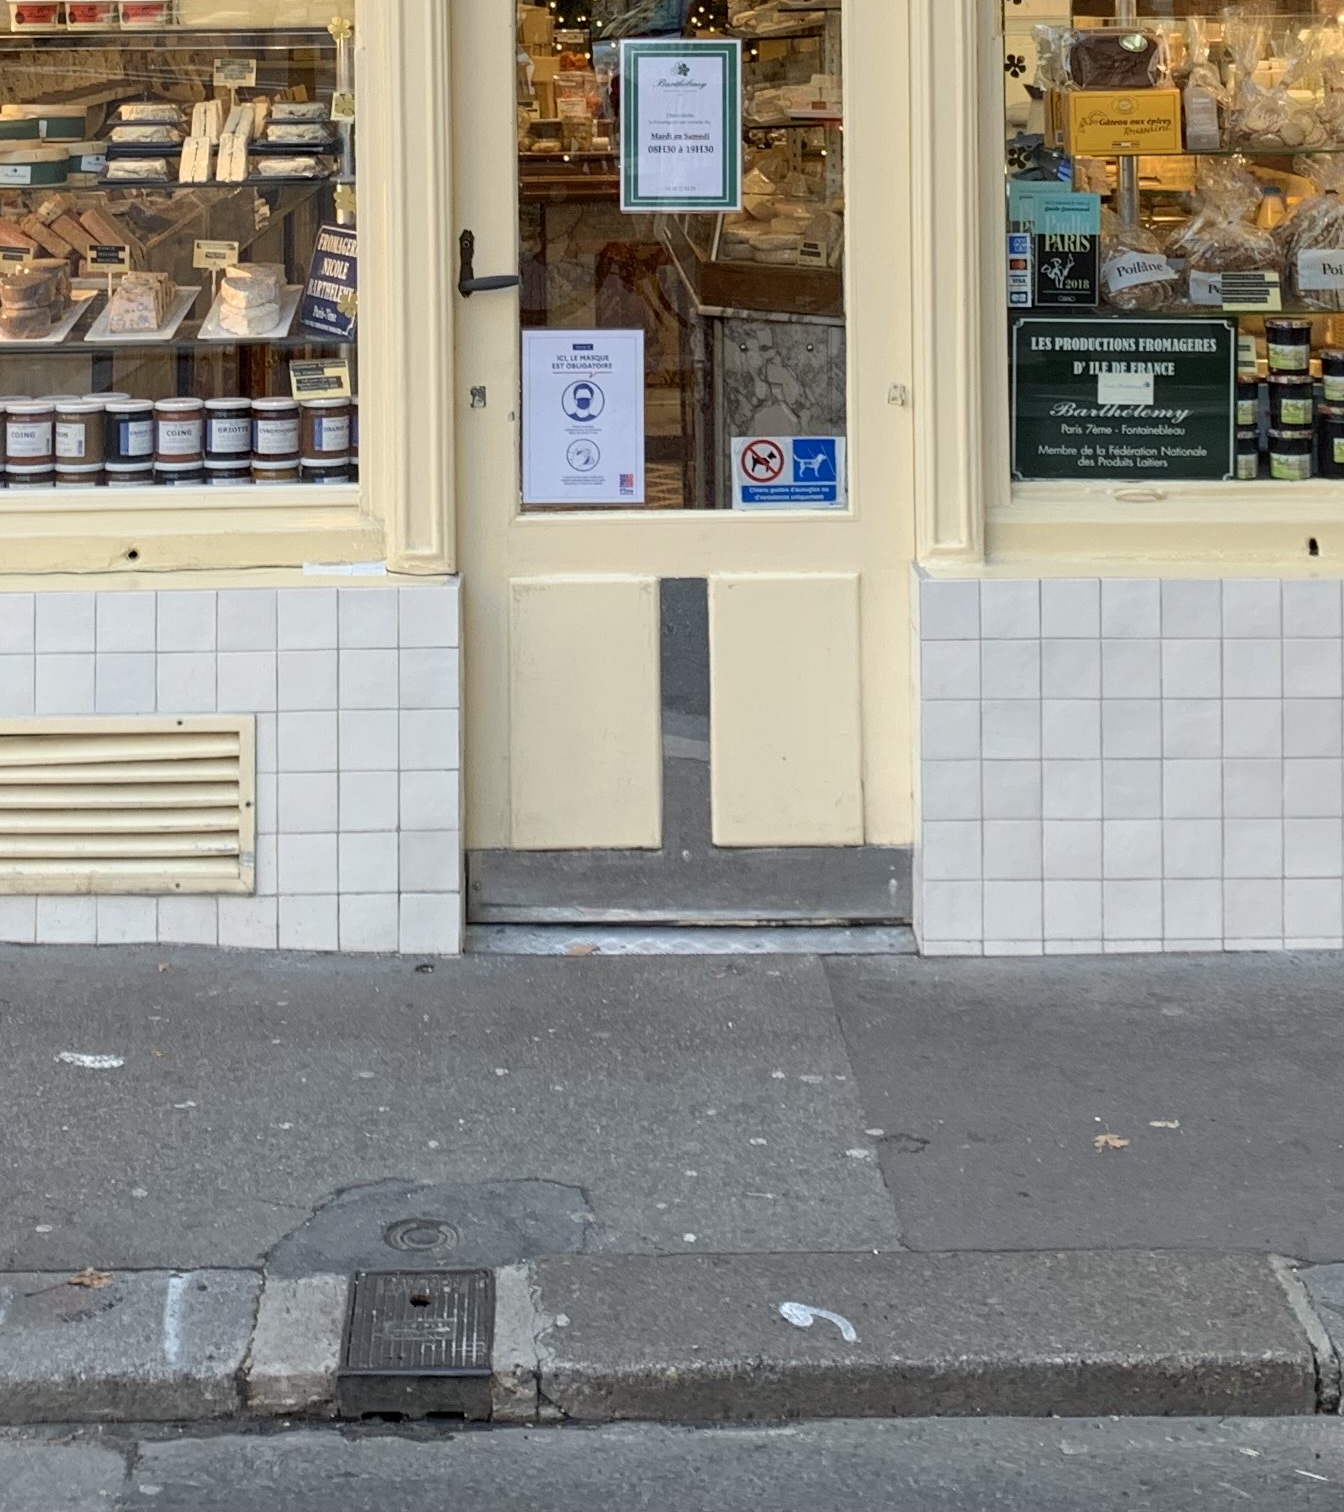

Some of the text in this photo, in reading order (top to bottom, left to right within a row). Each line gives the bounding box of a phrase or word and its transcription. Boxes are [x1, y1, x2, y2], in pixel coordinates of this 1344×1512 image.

[651, 132, 672, 140] Mardi
[684, 132, 710, 140] Samedi
[678, 145, 683, 154] à
[686, 145, 714, 154] 19H30
[1044, 234, 1091, 253] PARIS
[321, 257, 350, 281] NICOLE
[1116, 260, 1164, 278] Poilâne
[1065, 279, 1090, 289] 2018
[1031, 337, 1217, 352] LES PRODUCTIONS FROMAGERES
[580, 355, 609, 363] MASQUE
[1073, 361, 1175, 376] D' ILE DE FRANCE
[11, 431, 36, 439] COING
[166, 429, 193, 437] COING
[217, 426, 249, 434] GRIOTTE
[1061, 424, 1083, 434] Paris
[1086, 424, 1112, 434] 7ème
[1121, 424, 1186, 435] Fontainebleau
[1038, 445, 1207, 456] Membre de la Fédération Nationale
[1078, 457, 1168, 468] des Produits Laitiers
